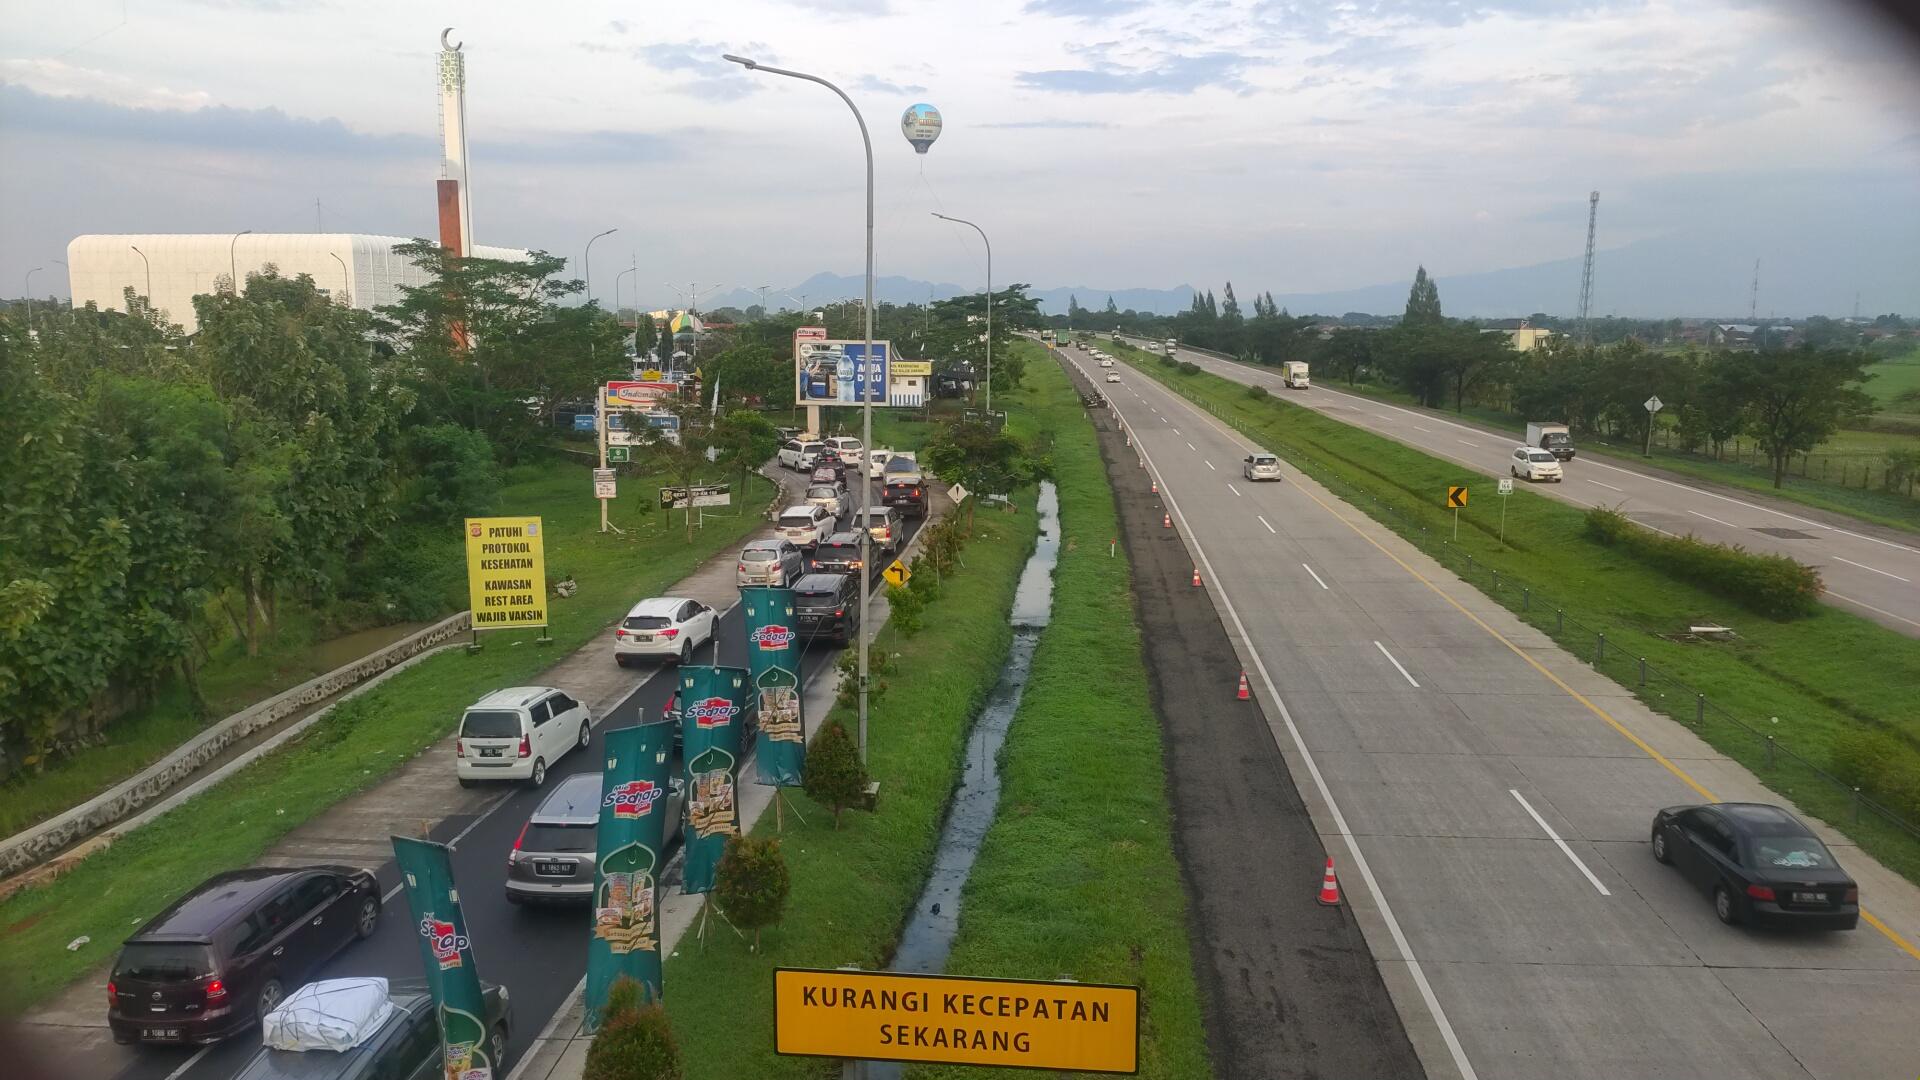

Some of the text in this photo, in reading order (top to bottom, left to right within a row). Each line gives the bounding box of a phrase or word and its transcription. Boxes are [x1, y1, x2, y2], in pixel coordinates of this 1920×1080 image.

[489, 527, 522, 538] PATUHI
[482, 543, 531, 554] PROTOKOL
[481, 559, 533, 570] KESEHATAN
[485, 579, 532, 590] KAWASAN
[484, 595, 533, 606] REST AREA
[476, 610, 543, 622] WAJIB VAKSIN
[603, 788, 662, 807] Sedap
[420, 920, 470, 952] Seap
[803, 986, 1110, 1022] KURANGI KECEPATAN
[880, 1024, 1031, 1053] SEKARANG
